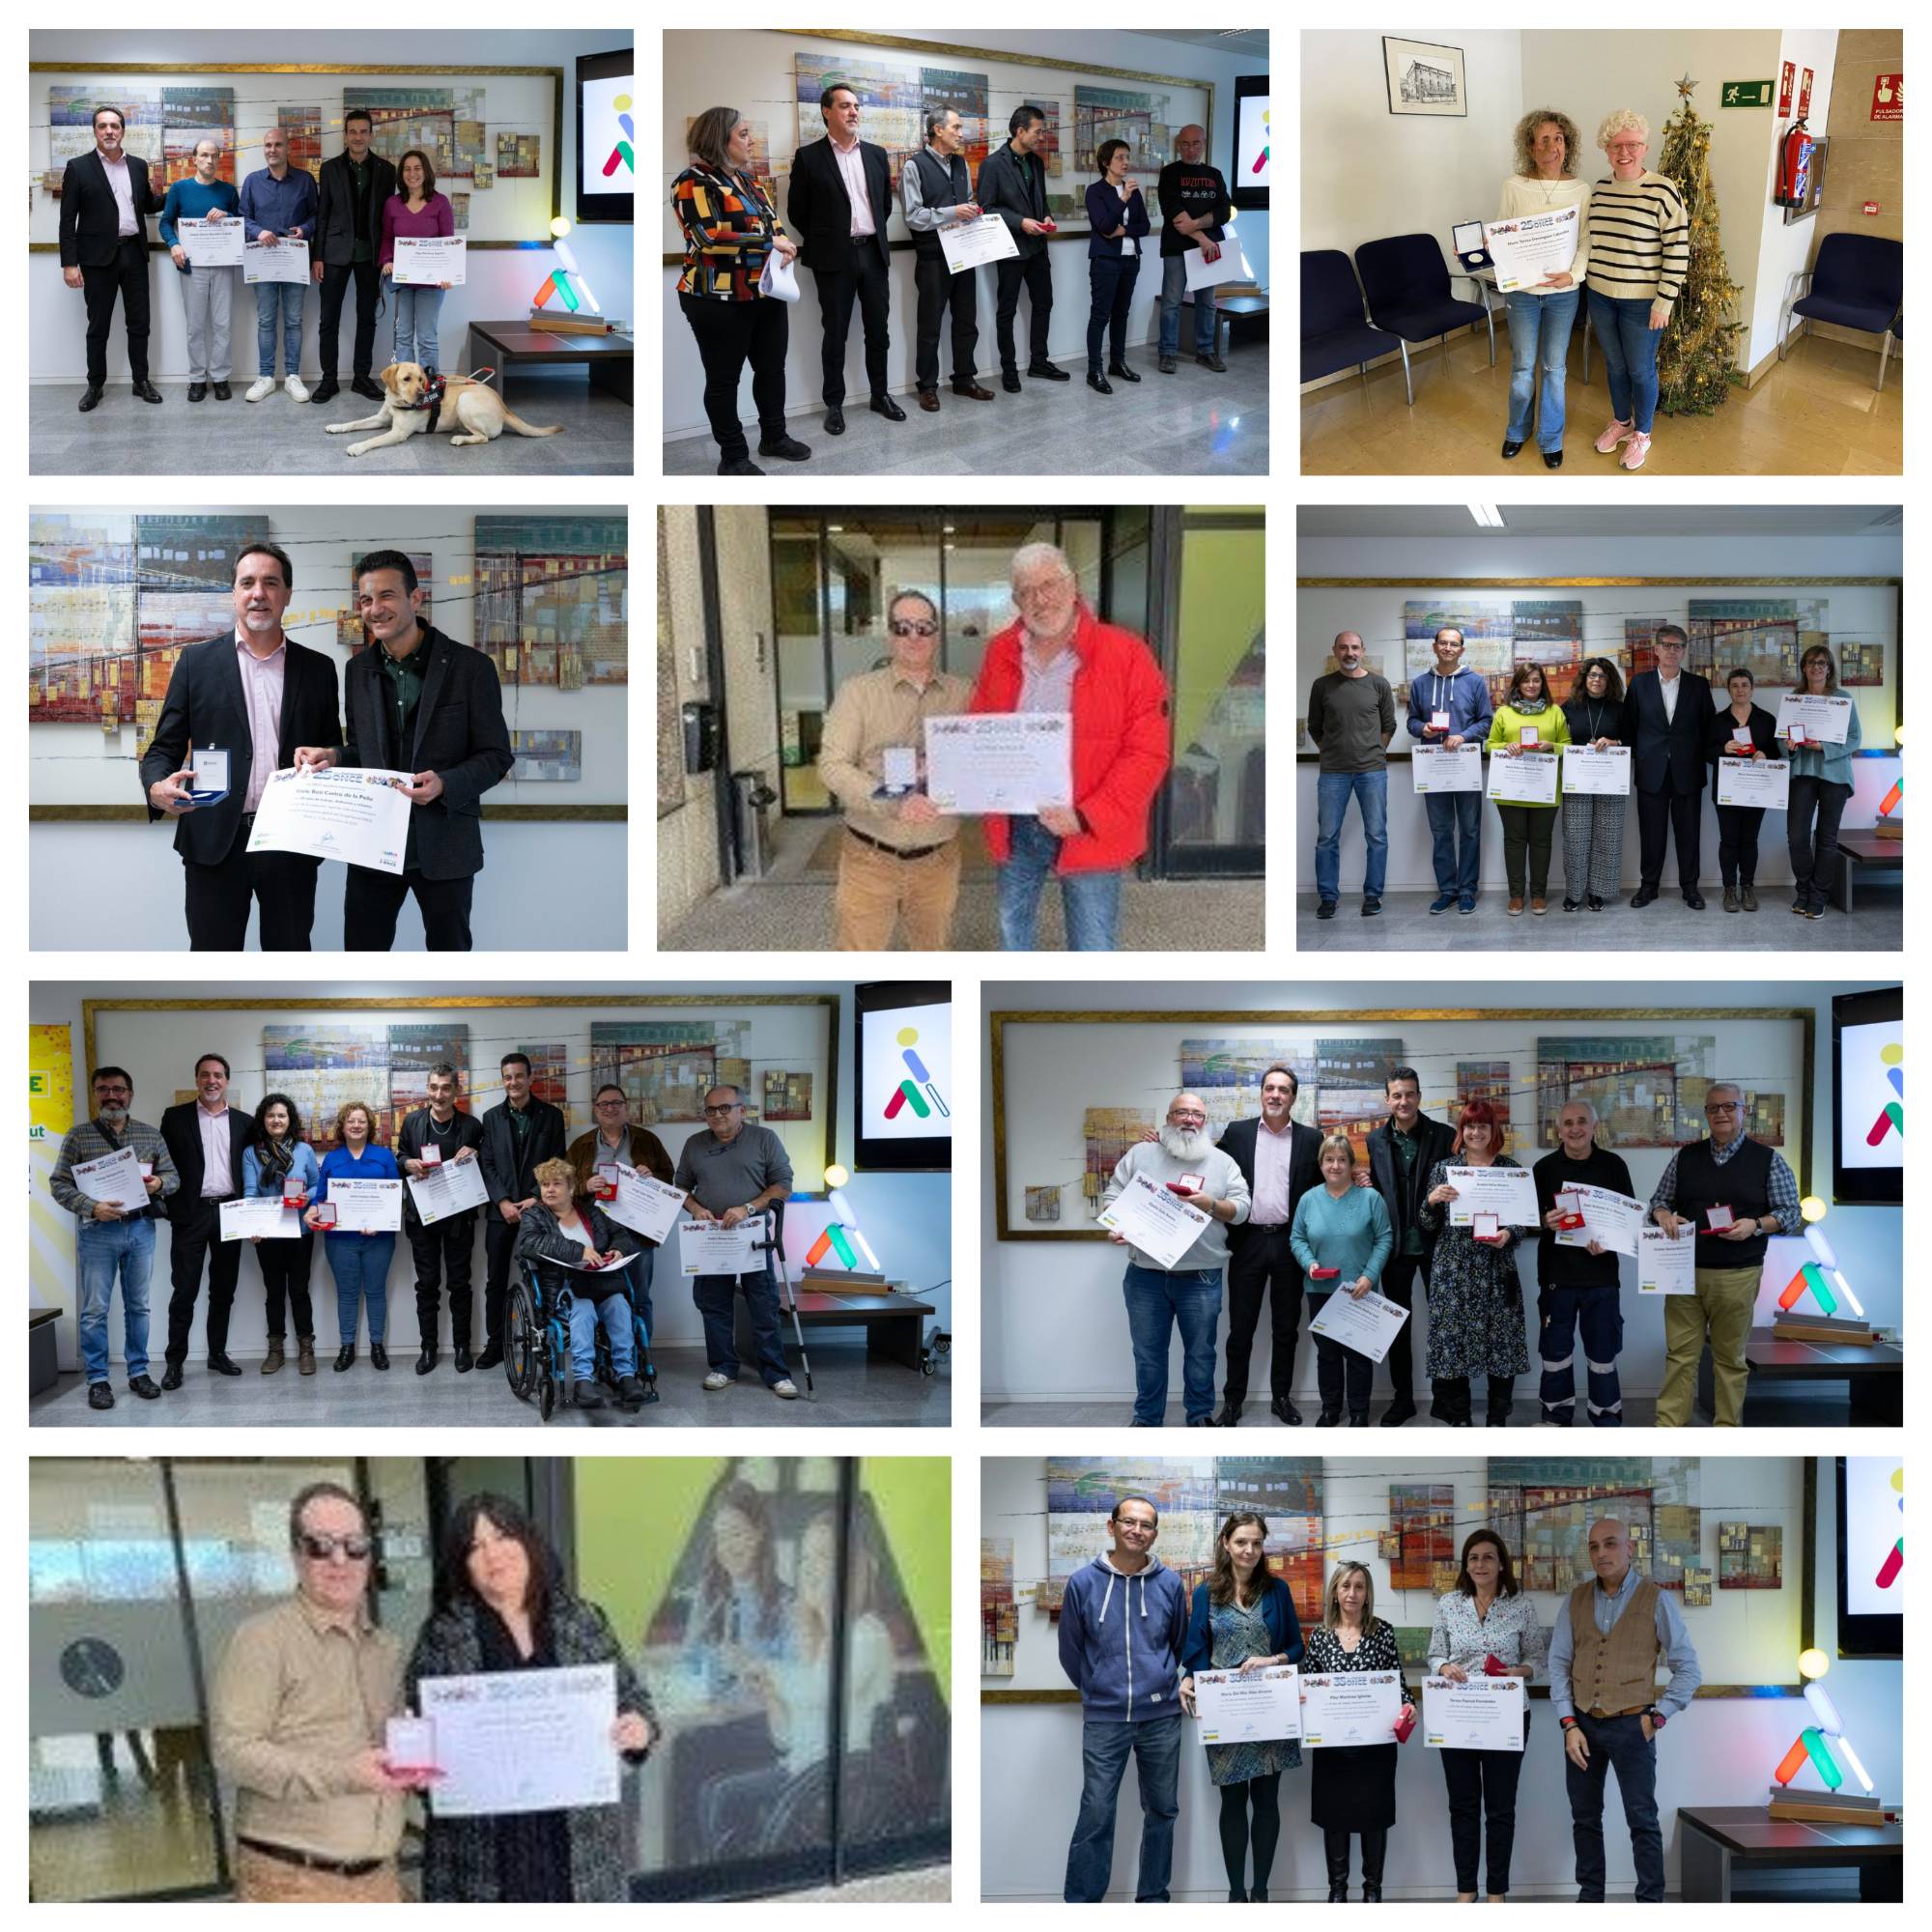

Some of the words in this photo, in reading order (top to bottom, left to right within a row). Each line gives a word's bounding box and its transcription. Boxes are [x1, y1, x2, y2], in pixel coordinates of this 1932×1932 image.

[1520, 220, 1534, 231] 25
[1534, 218, 1554, 228] ONCE
[332, 774, 363, 783] ONCE
[30, 1076, 43, 1092] E
